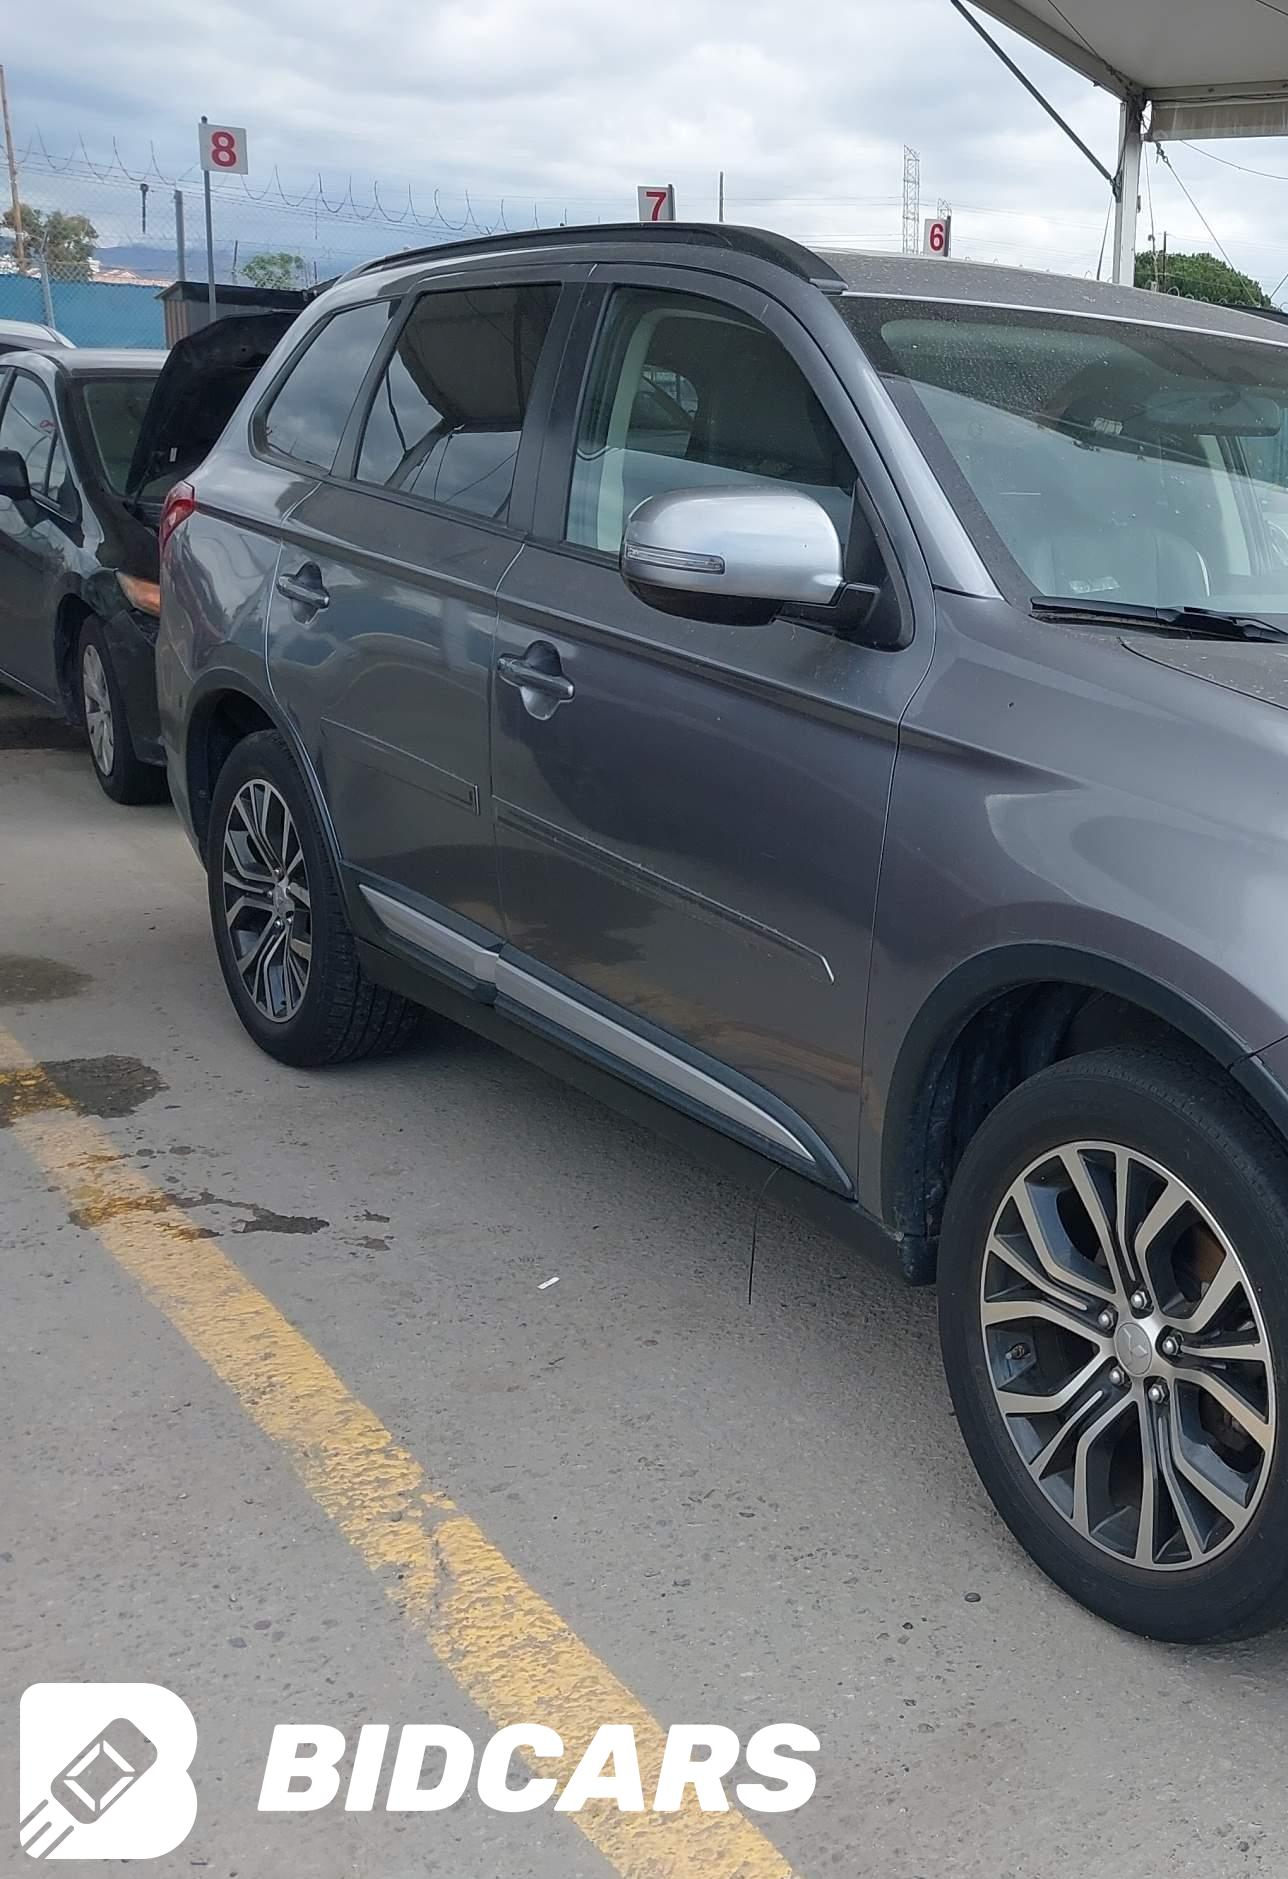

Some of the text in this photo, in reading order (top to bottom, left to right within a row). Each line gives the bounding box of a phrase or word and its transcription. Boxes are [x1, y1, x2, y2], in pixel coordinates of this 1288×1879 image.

[211, 131, 237, 167] 8
[646, 191, 667, 221] 7
[930, 223, 944, 251] 6
